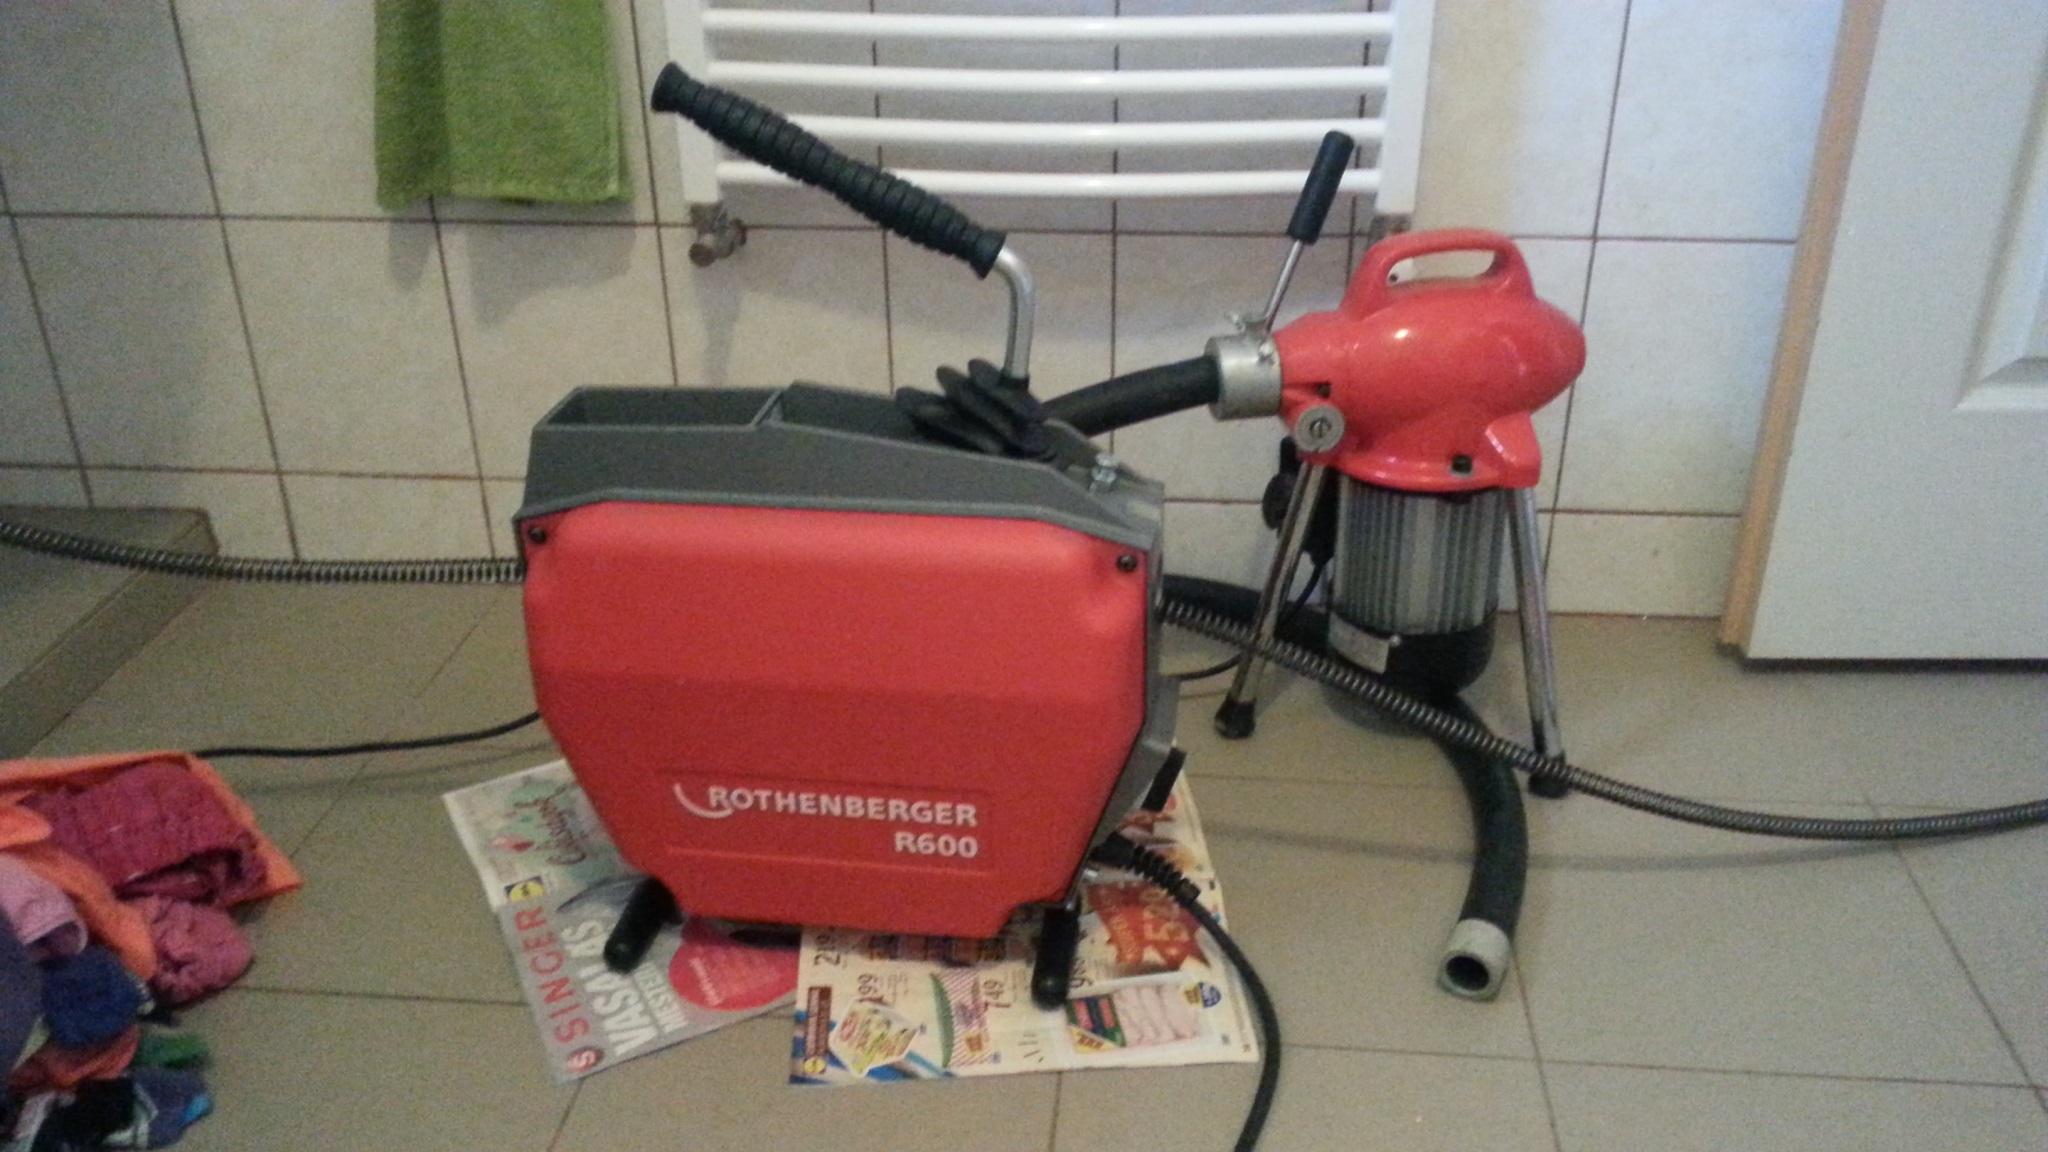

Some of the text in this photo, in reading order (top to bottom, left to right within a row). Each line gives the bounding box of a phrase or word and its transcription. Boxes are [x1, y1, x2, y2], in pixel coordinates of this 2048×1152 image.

[708, 786, 978, 827] ROTHENBERGER
[893, 831, 979, 858] R600
[514, 906, 591, 1043] SINGER
